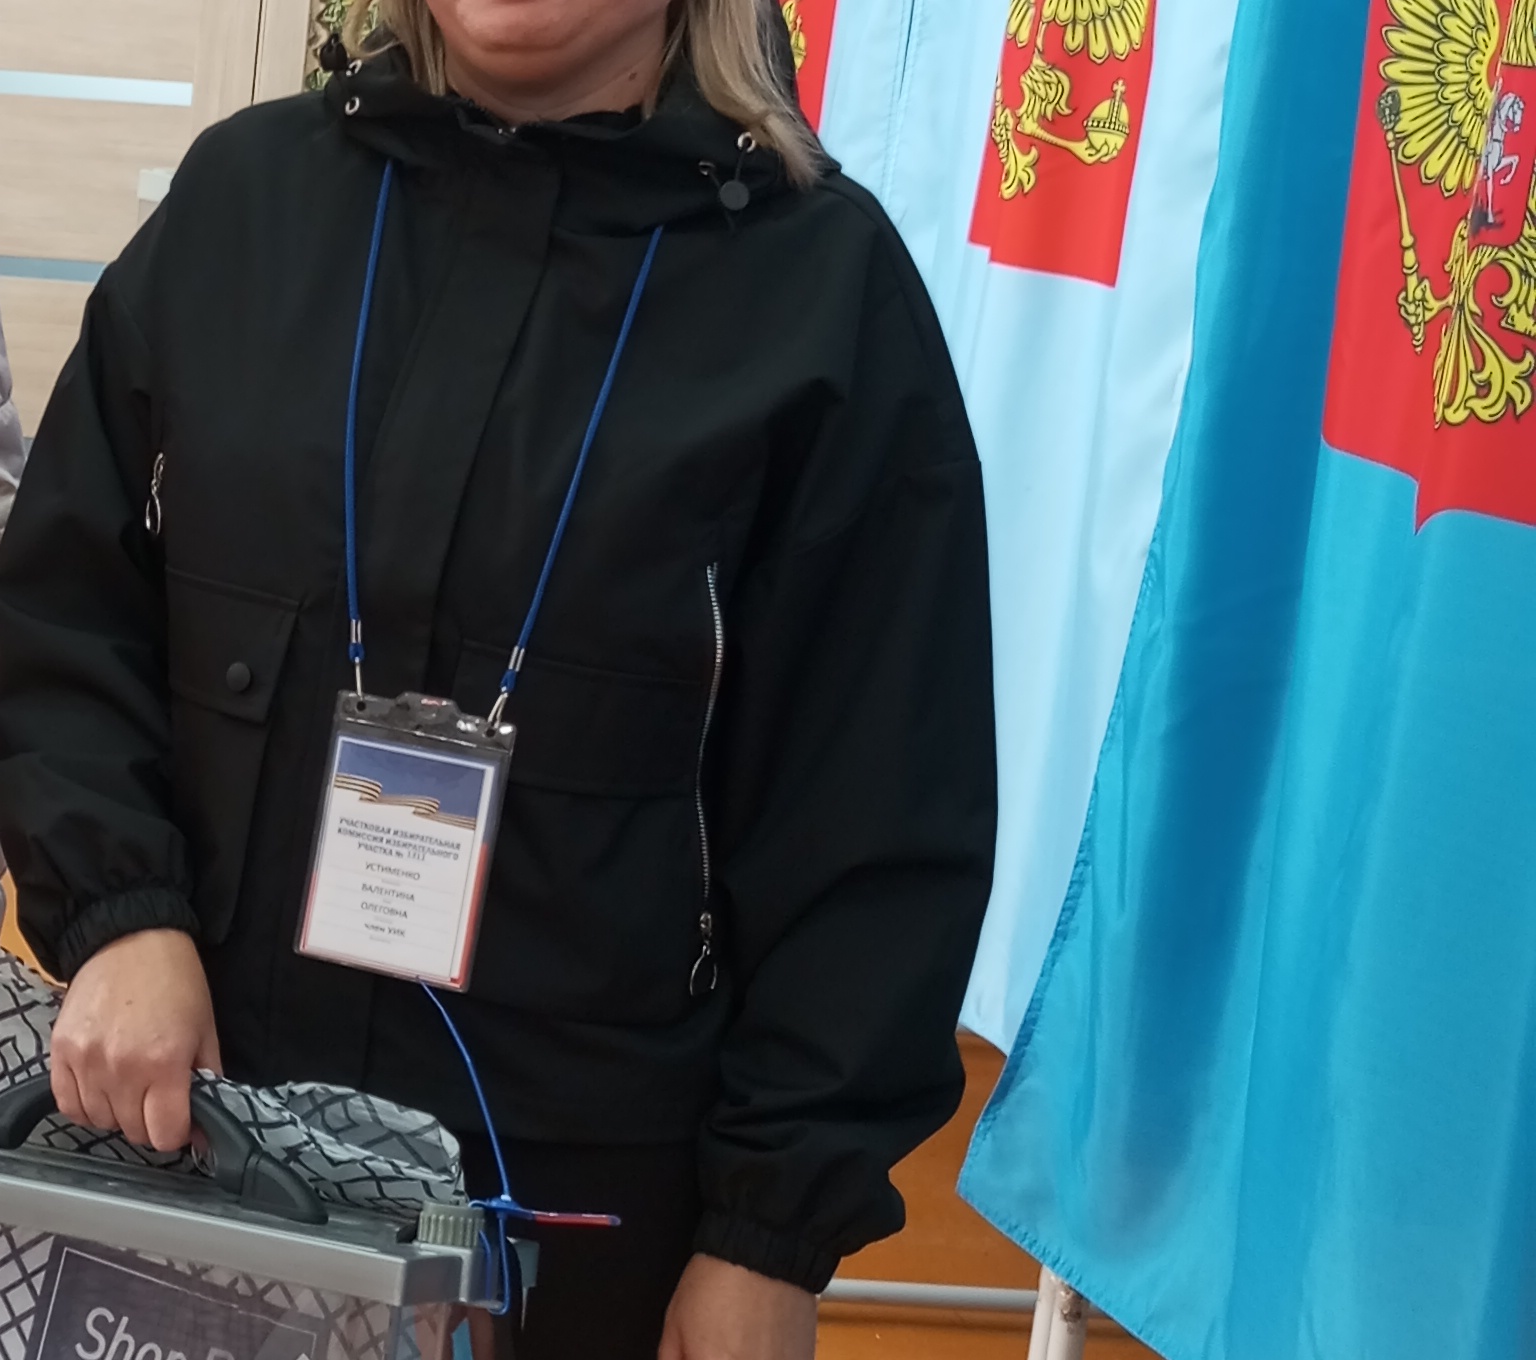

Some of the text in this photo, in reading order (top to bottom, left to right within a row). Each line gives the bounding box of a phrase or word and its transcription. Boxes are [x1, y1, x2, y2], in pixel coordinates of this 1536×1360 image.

[339, 817, 460, 850] УЧАСТКОВАЯ ИЗБИРАТЕЛЬНАЯ
[337, 828, 458, 860] КОМИССИЯ ИЗБИРАТЕЛЬНОГО
[357, 842, 393, 856] УЧАСТКА
[365, 862, 420, 880] УСТИМЕНКО
[361, 884, 414, 902] ВАЛЕНТИНА
[361, 902, 407, 919] ОЛЕГОВНА
